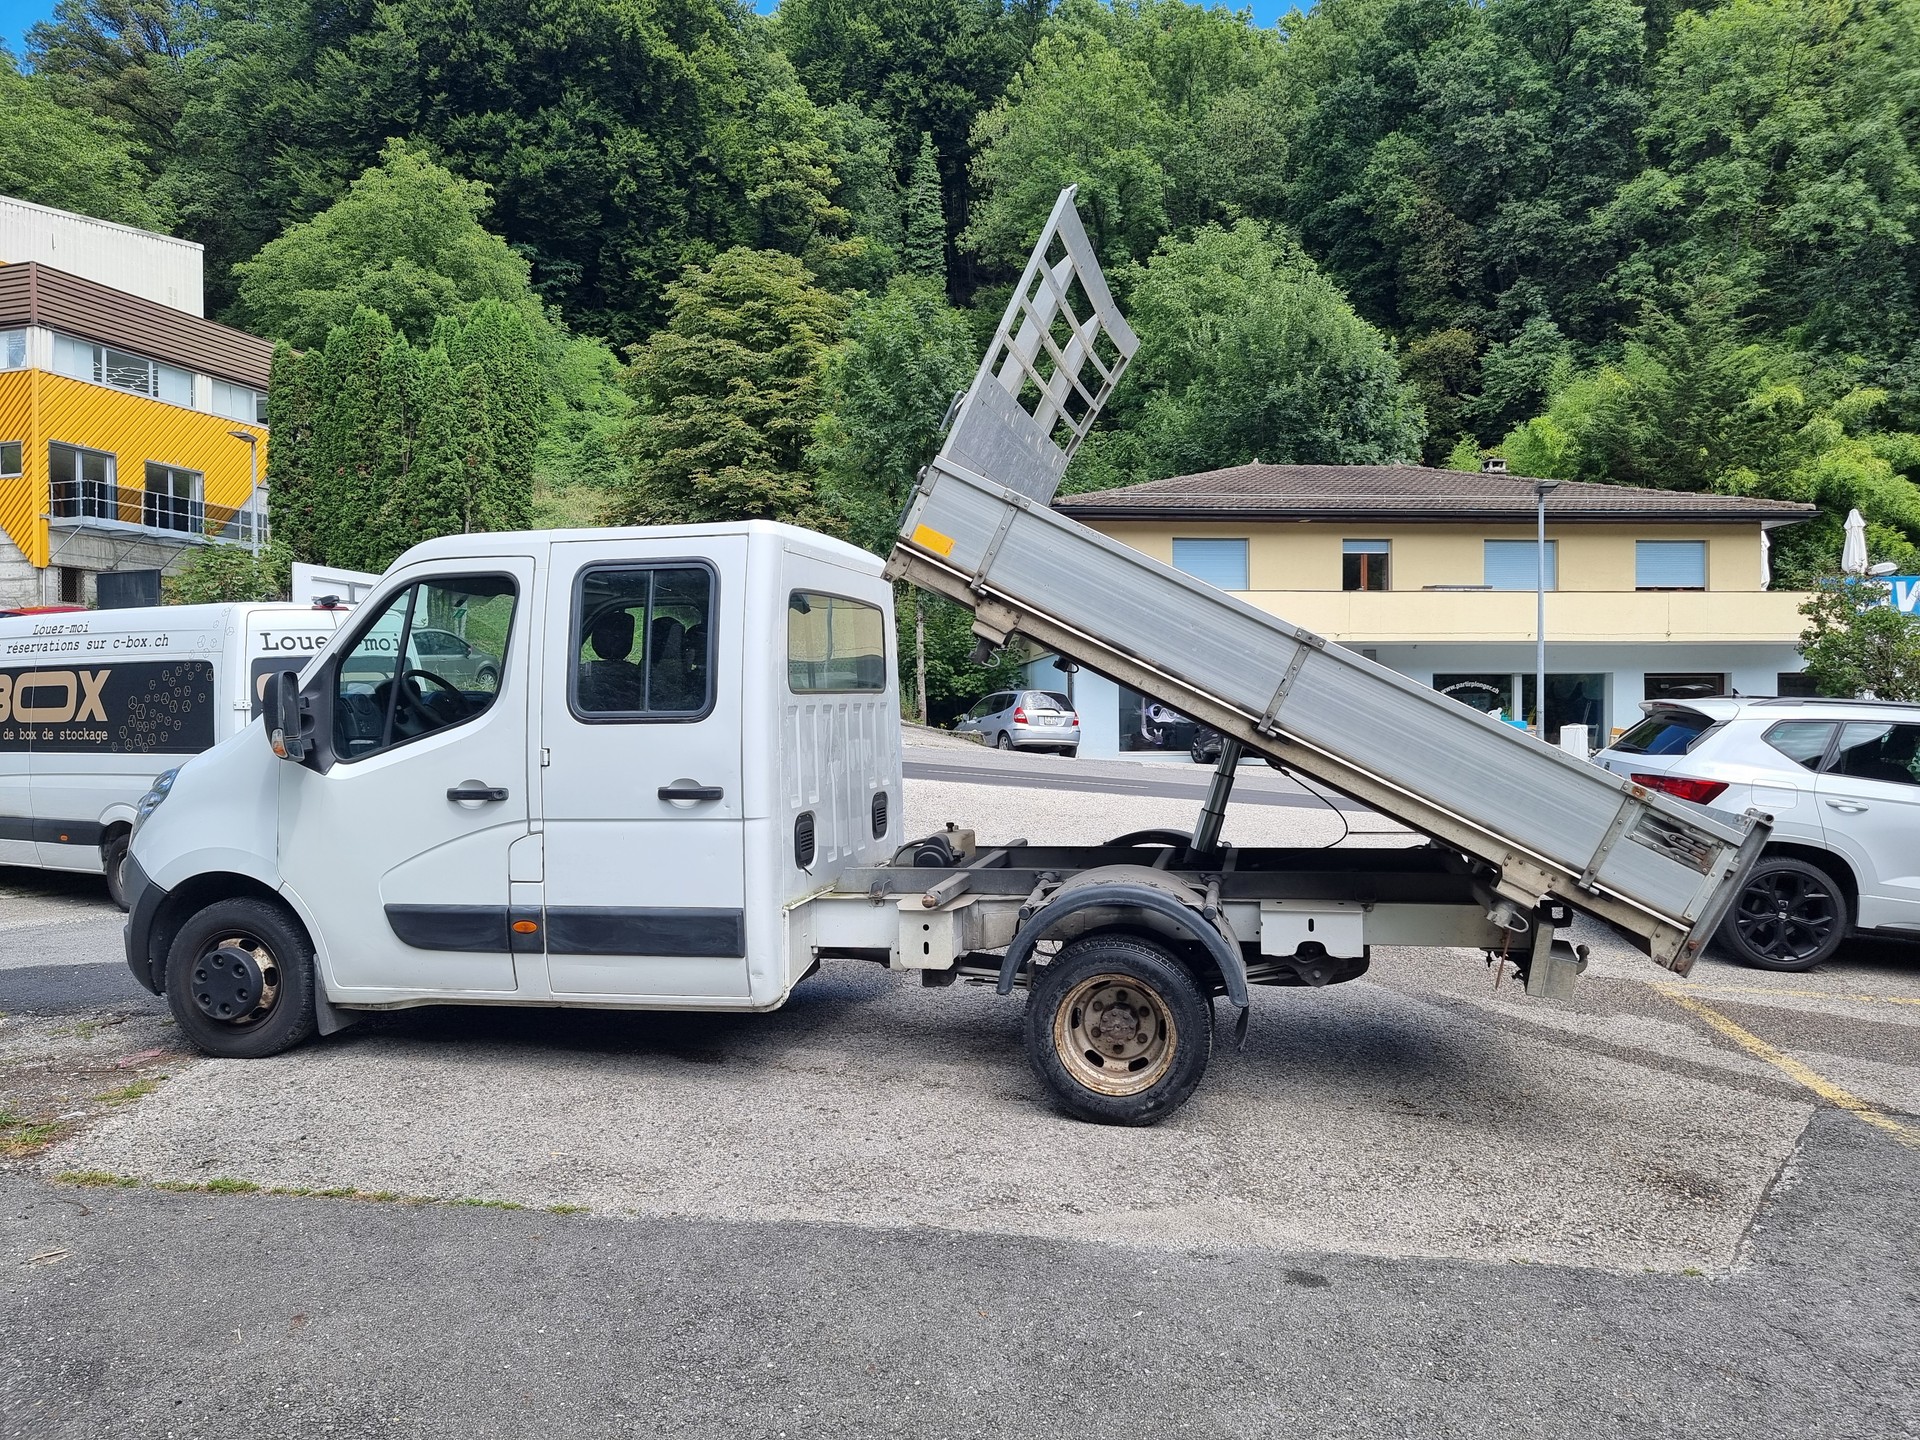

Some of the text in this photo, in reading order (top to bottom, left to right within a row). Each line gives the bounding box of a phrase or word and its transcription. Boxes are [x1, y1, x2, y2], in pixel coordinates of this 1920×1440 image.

[32, 621, 90, 636] Louez-moi
[6, 633, 169, 655] réservations sur c-box.ch
[0, 669, 112, 724] OX
[2, 727, 109, 744] de box de stockage
